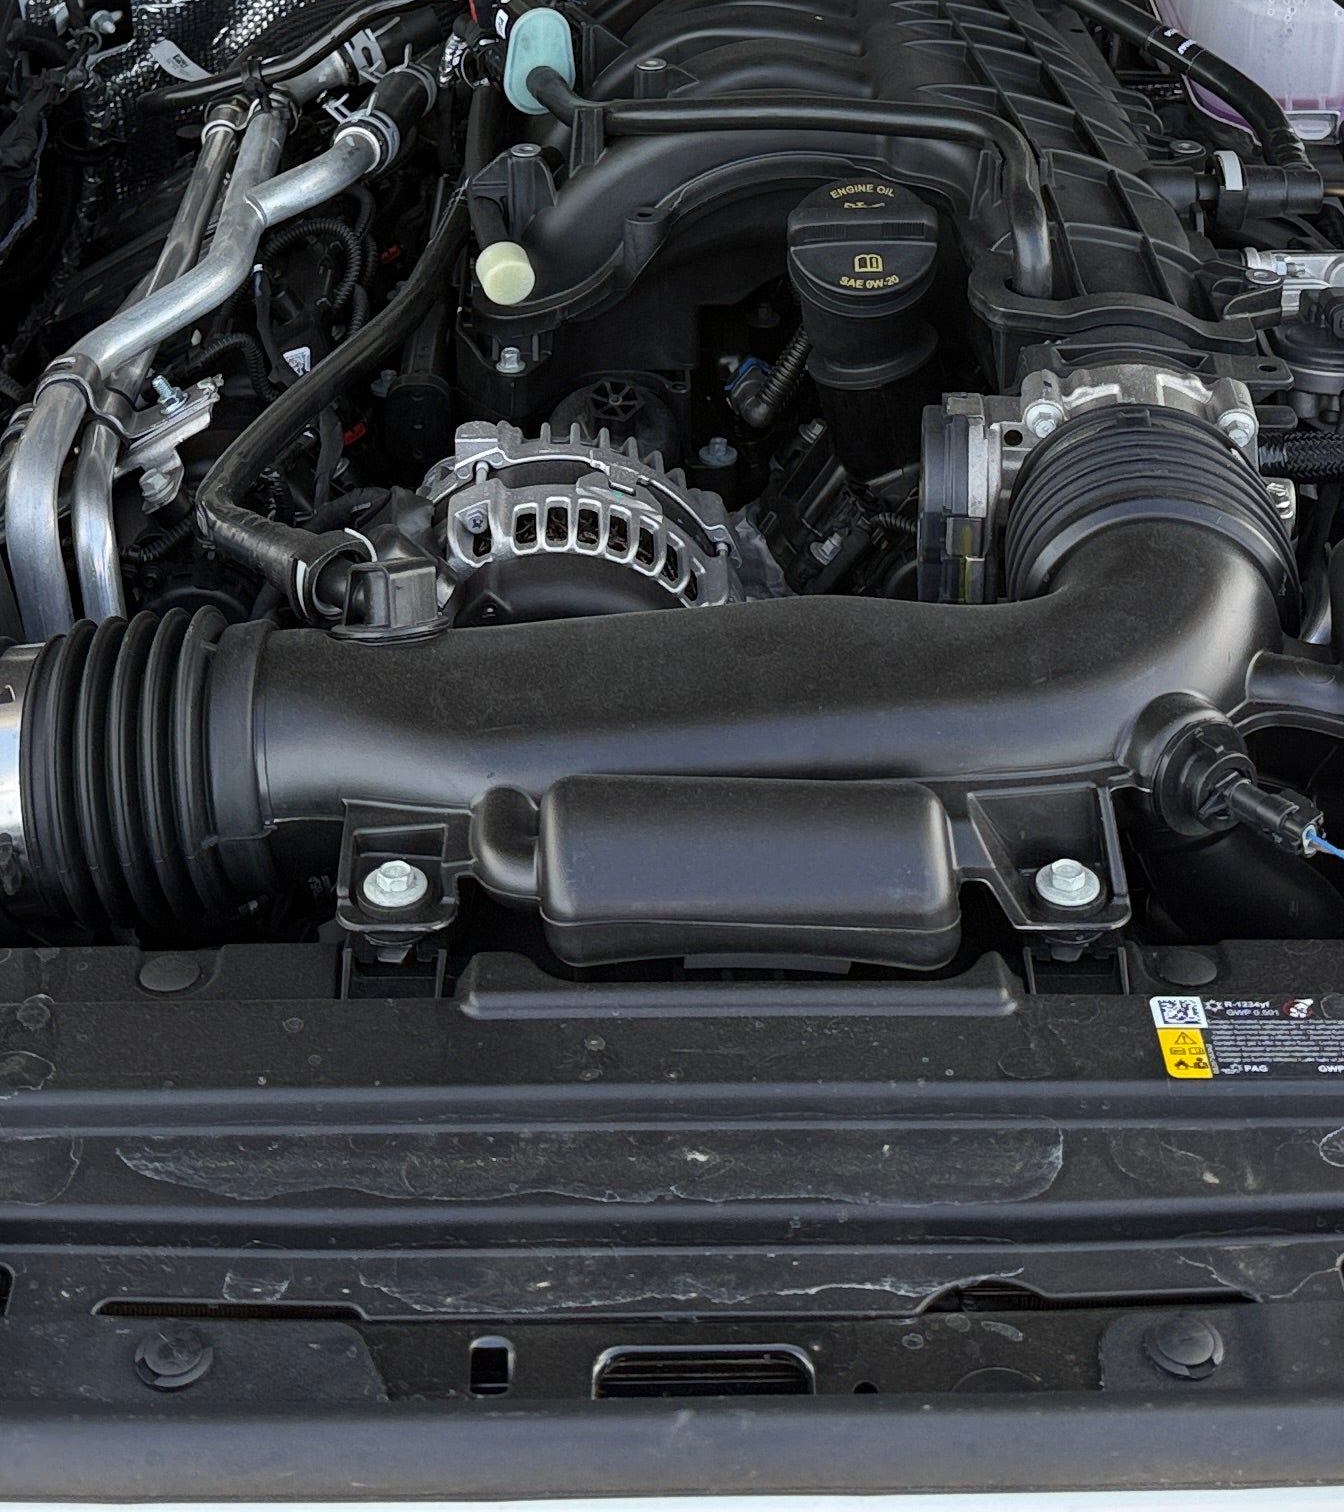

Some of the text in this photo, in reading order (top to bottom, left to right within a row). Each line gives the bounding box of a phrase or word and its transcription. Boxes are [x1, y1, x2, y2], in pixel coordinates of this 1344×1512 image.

[829, 183, 896, 199] ENGINE OIL
[839, 274, 900, 289] SAE 0W-20
[1243, 1064, 1269, 1073] PAG
